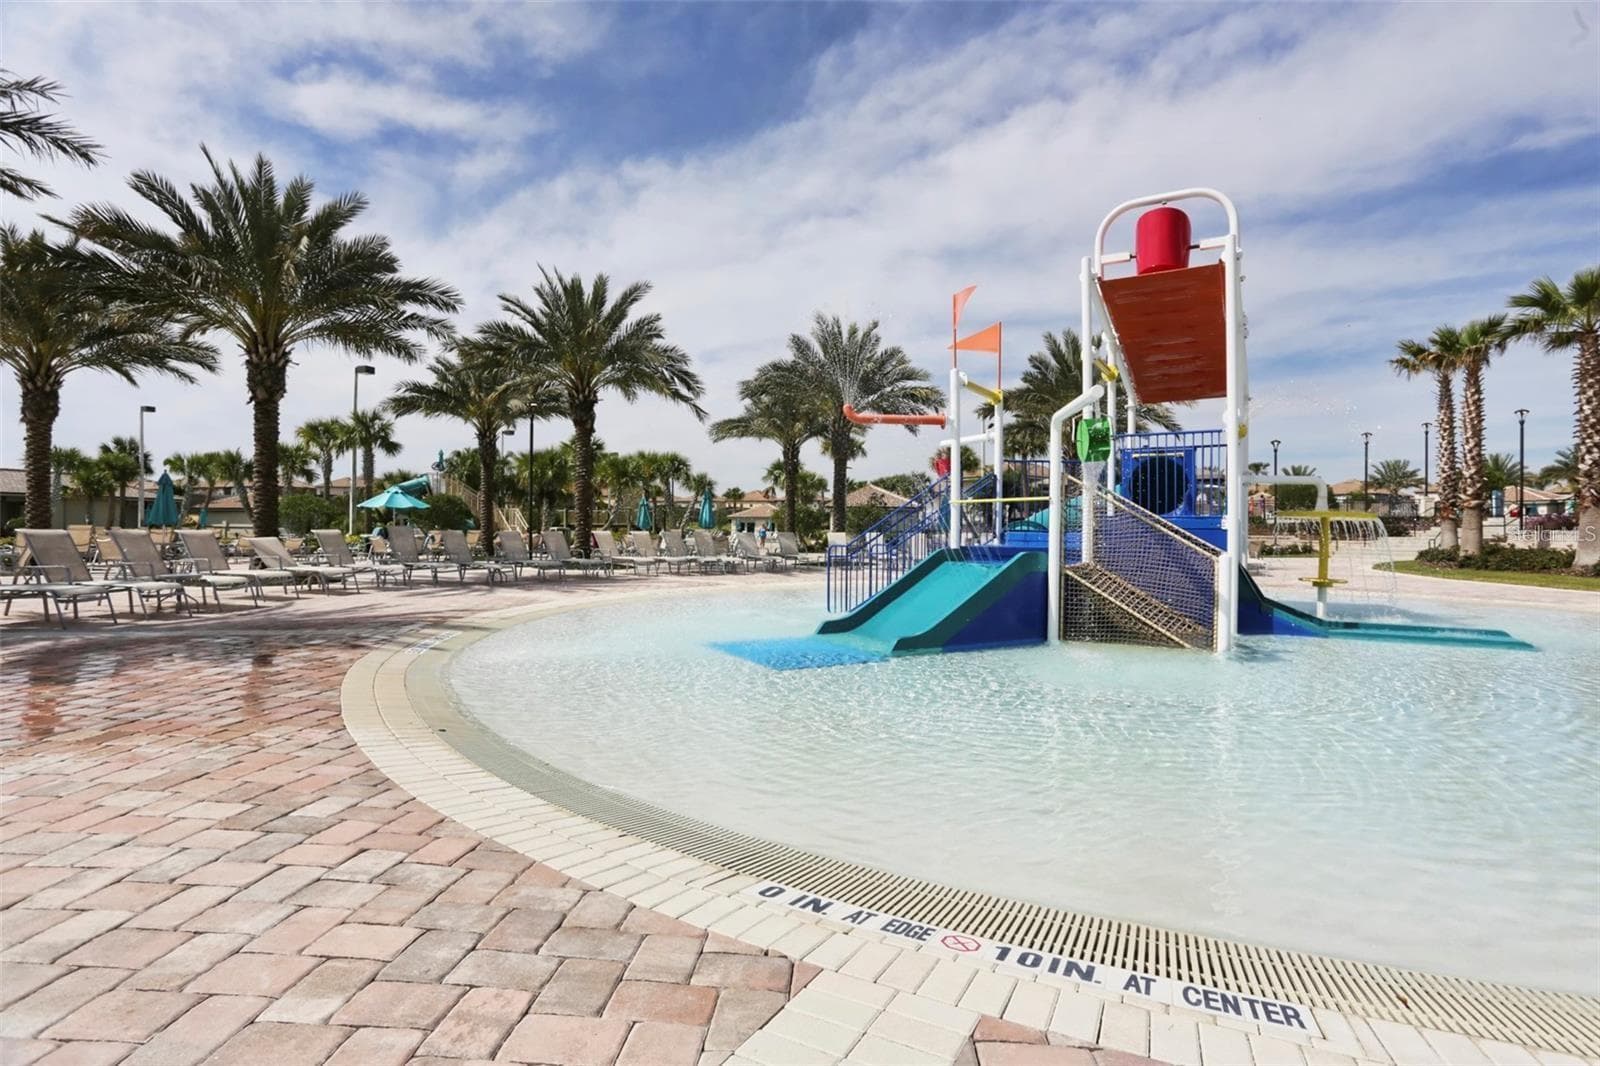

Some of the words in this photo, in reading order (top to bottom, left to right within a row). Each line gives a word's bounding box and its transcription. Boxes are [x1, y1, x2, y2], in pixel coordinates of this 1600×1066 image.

[788, 894, 834, 915] IN.
[841, 910, 878, 925] AT
[880, 918, 936, 941] EDGE
[1123, 974, 1157, 996] AT
[1182, 986, 1307, 1030] CENTER
